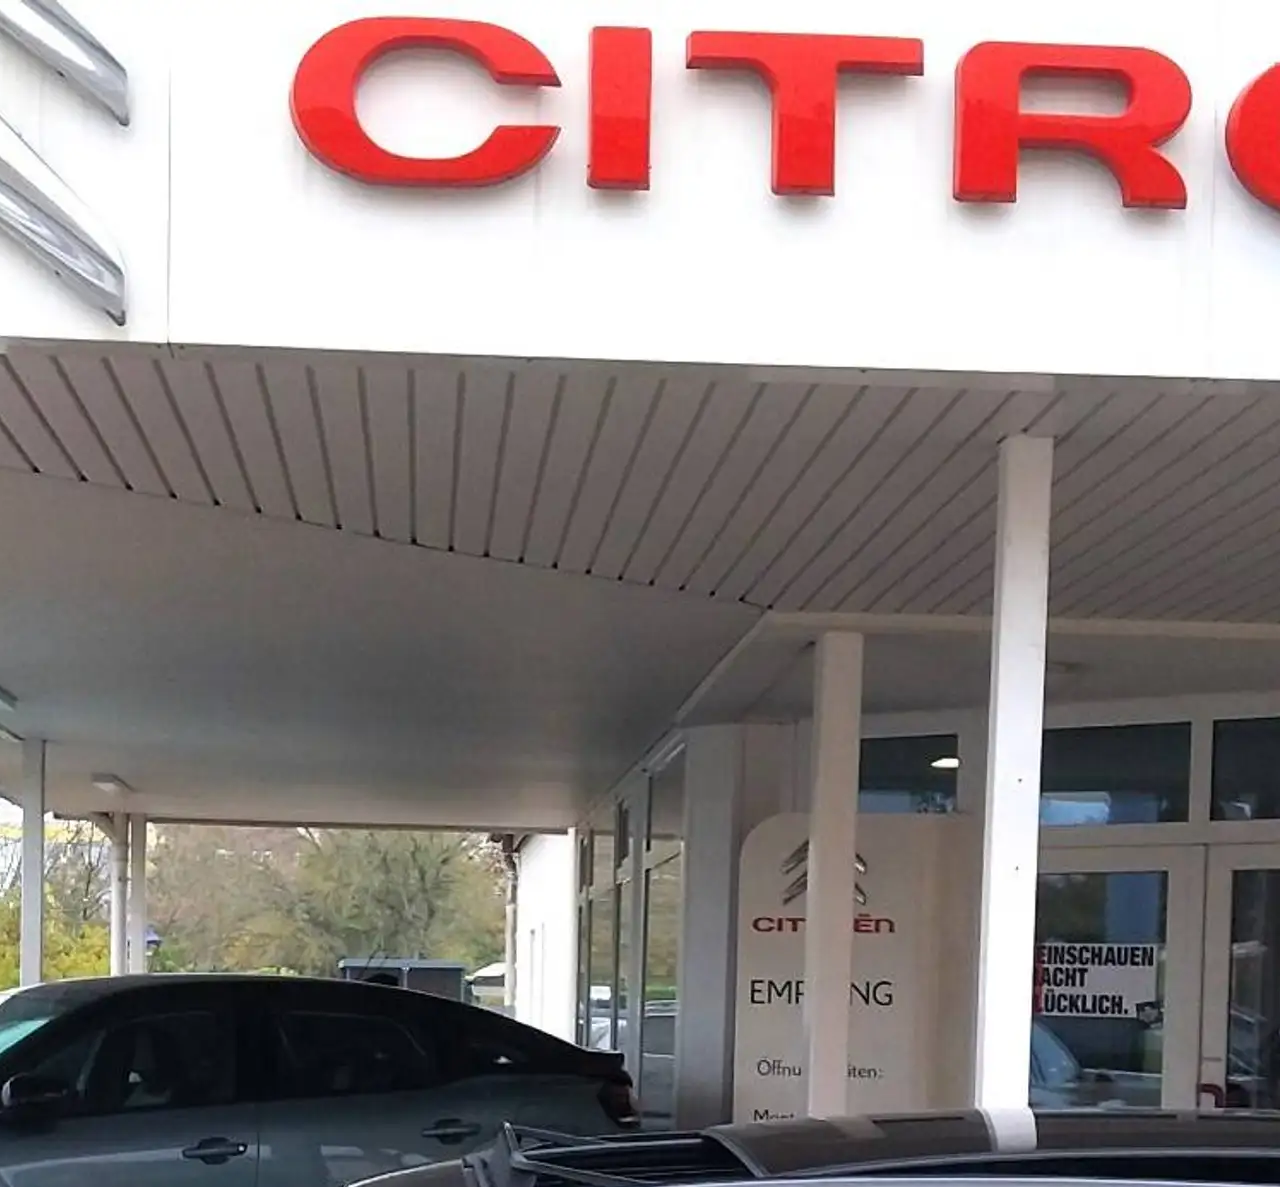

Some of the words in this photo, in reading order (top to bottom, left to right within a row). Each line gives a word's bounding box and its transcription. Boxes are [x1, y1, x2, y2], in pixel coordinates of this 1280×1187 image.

[752, 913, 895, 933] CITËN
[1035, 945, 1154, 967] EINSCHAUEN
[1035, 967, 1089, 988] ACHT
[750, 979, 894, 1006] EMPNG
